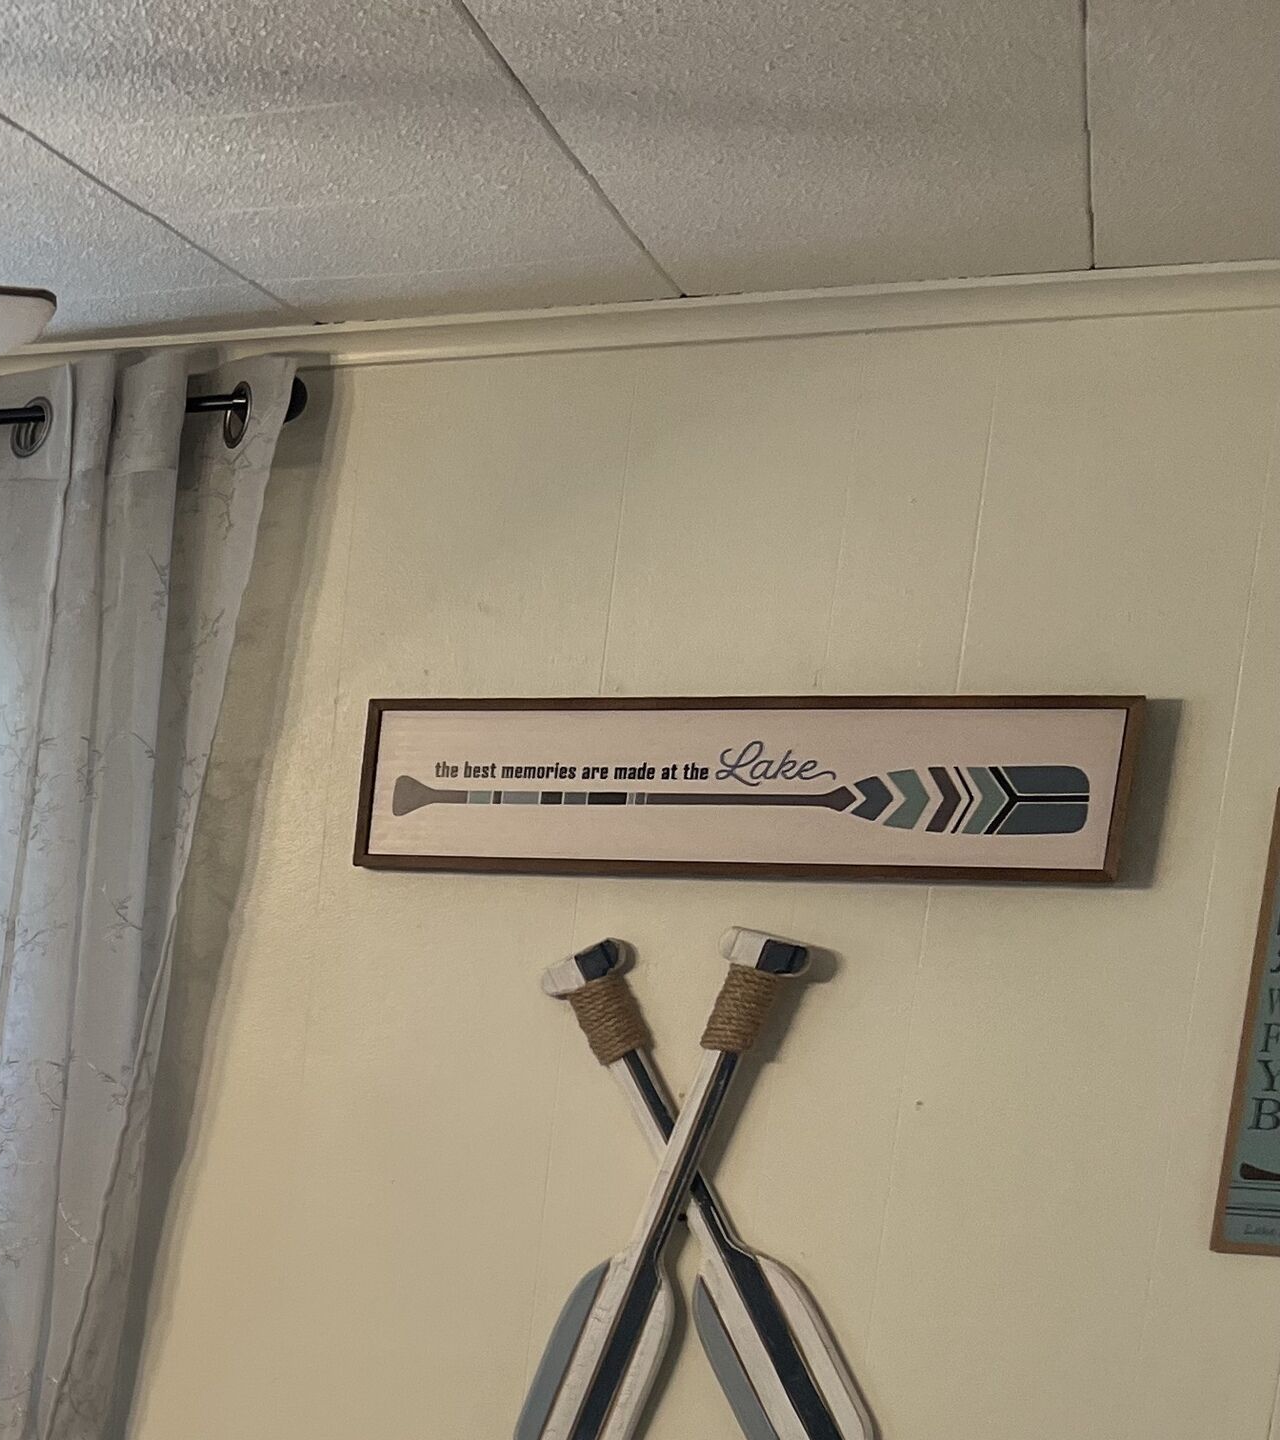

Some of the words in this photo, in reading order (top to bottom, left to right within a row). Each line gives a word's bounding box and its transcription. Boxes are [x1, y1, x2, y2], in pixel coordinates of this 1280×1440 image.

[434, 760, 459, 779] the
[463, 760, 497, 779] best
[501, 762, 577, 780] memories
[581, 765, 609, 780] are
[613, 762, 655, 780] made
[661, 763, 678, 780] at
[683, 762, 709, 780] the
[715, 740, 837, 787] Lake
